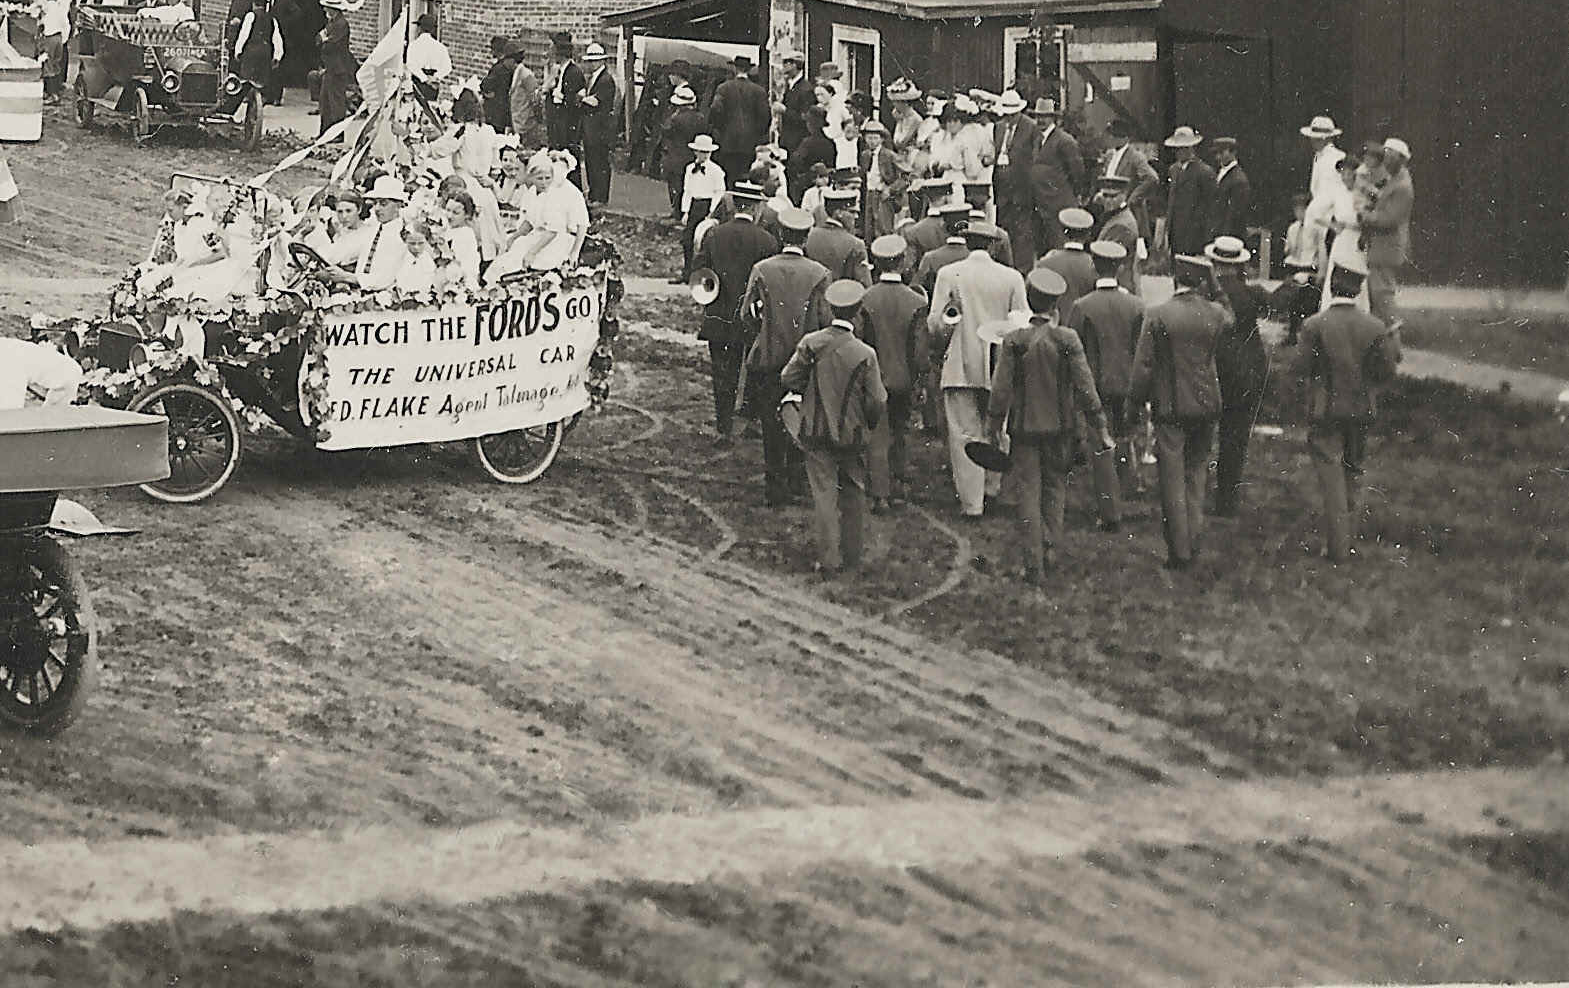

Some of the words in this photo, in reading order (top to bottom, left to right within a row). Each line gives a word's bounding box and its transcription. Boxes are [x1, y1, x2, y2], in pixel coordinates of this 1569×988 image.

[325, 320, 409, 347] WATCH
[421, 316, 467, 342] THE
[474, 292, 561, 346] FORDS
[565, 296, 591, 320] GO
[349, 367, 395, 385] THE
[415, 353, 517, 383] UNIVERSAL
[540, 345, 576, 365] CAR
[359, 394, 431, 421] FLAKE
